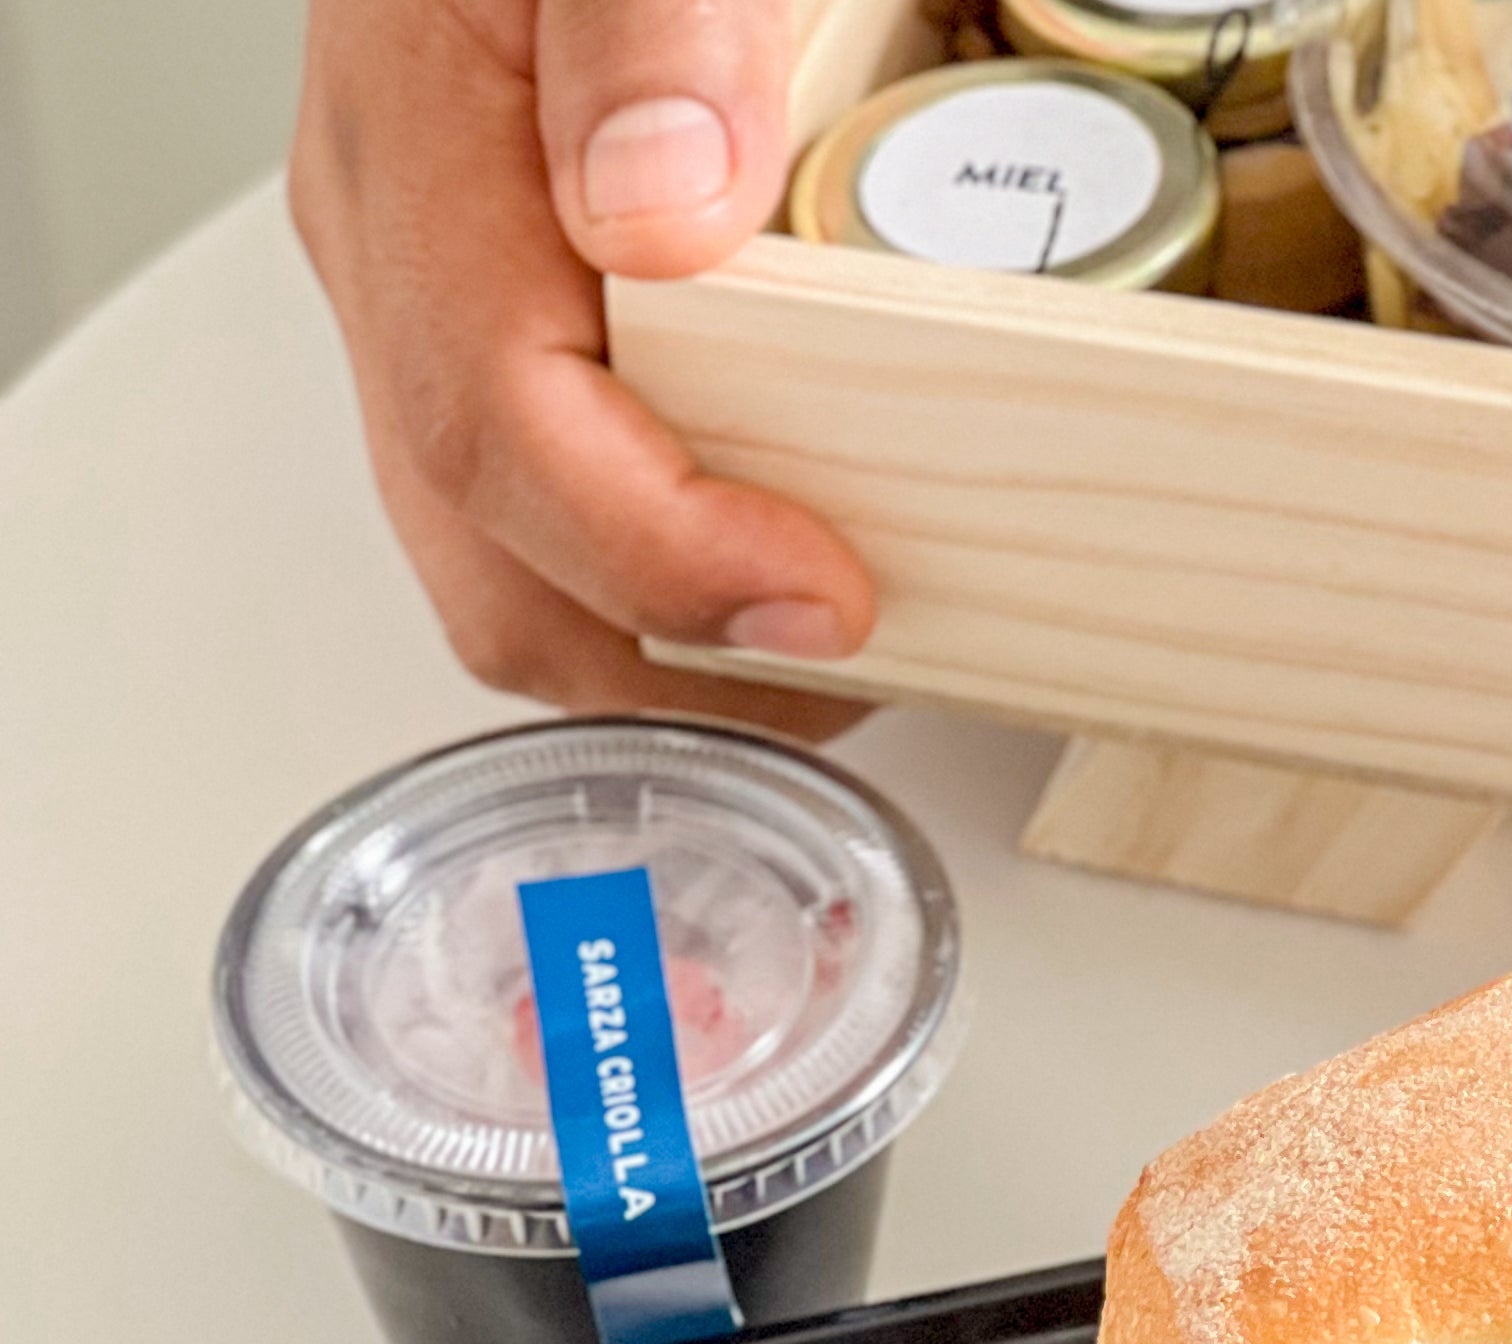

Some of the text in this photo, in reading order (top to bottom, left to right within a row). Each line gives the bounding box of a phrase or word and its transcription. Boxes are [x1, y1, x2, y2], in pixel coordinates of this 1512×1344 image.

[954, 160, 1067, 194] MIEL
[577, 938, 657, 1222] SARZA CRIOLLA
